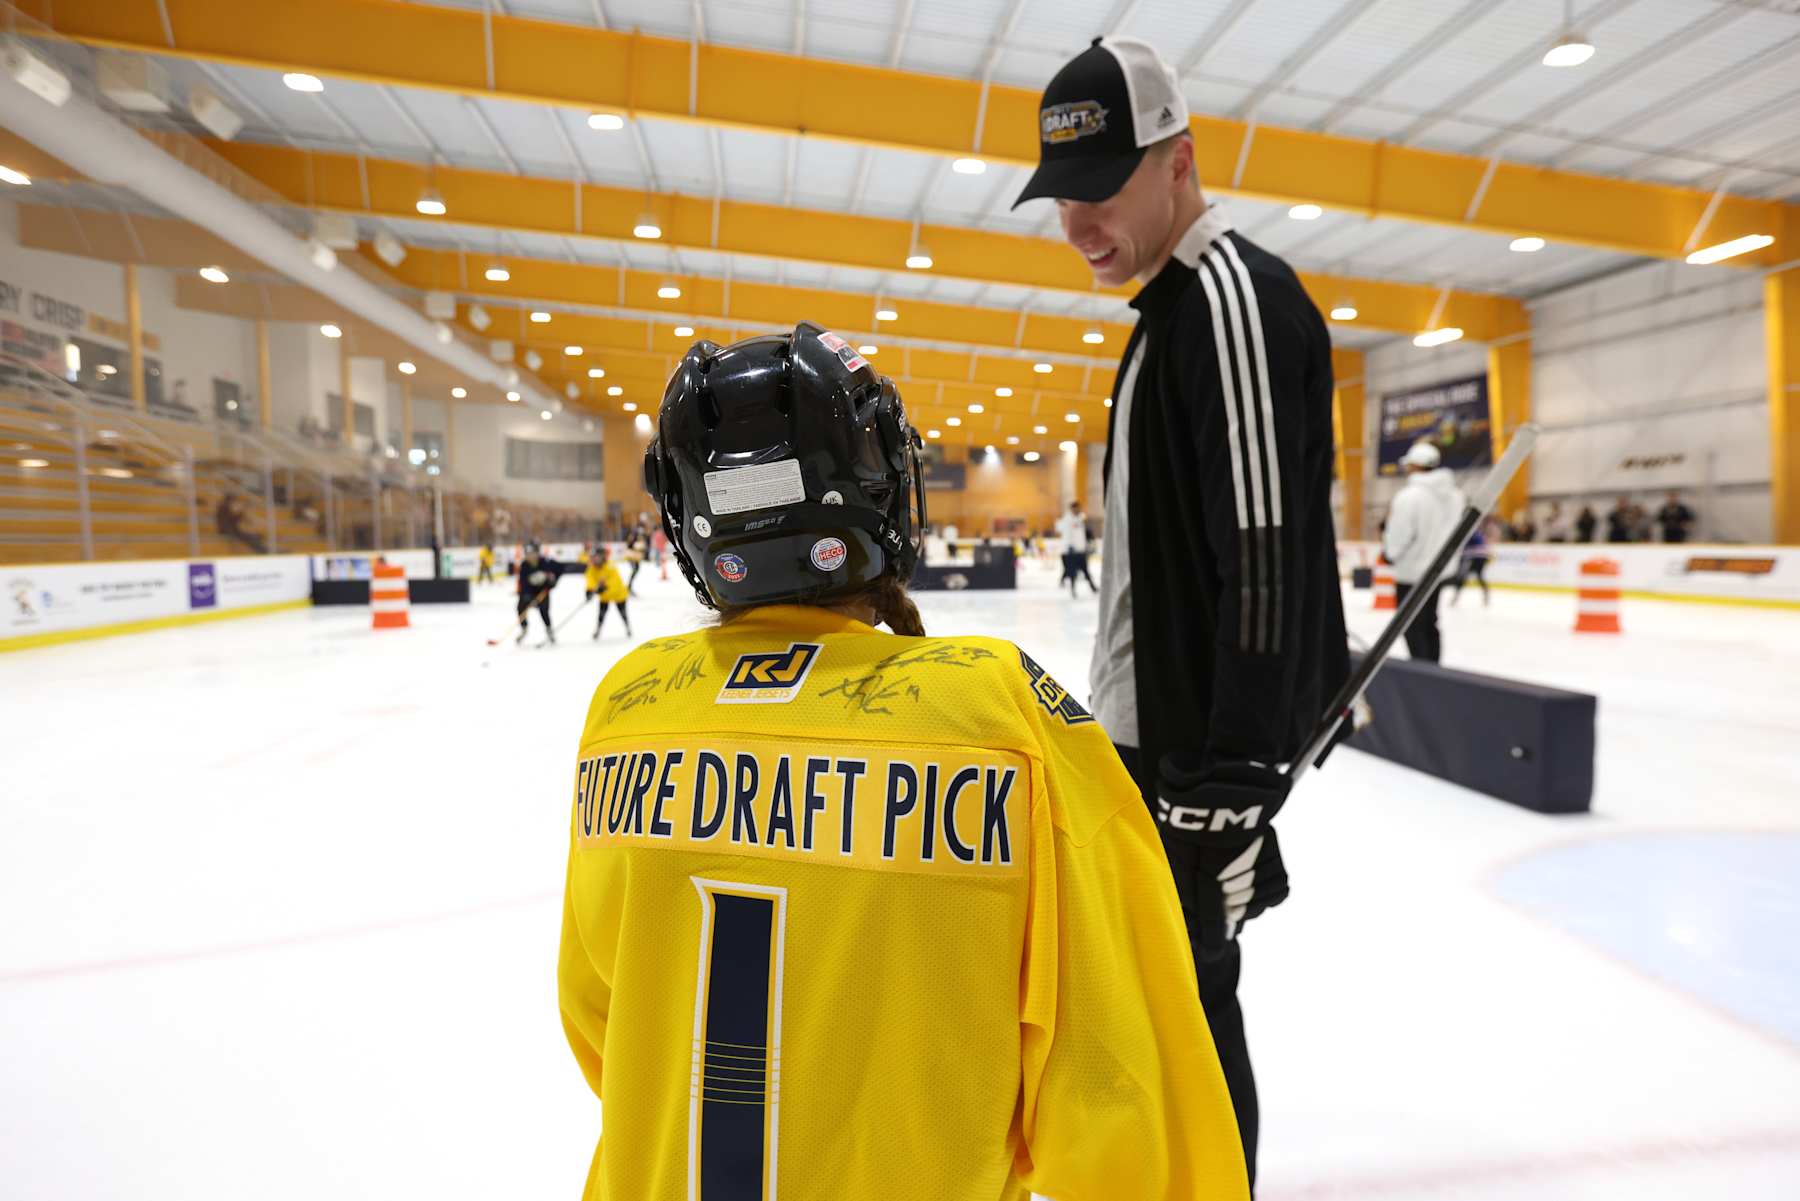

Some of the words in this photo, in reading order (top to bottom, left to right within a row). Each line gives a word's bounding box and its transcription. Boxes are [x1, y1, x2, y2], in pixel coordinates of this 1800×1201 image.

[1045, 110, 1089, 132] DRAFT
[733, 649, 811, 684] KJ
[577, 750, 686, 838] FUTURE
[690, 751, 866, 857] DRAFT
[881, 761, 1019, 866] PICK
[688, 875, 788, 1201] 1
